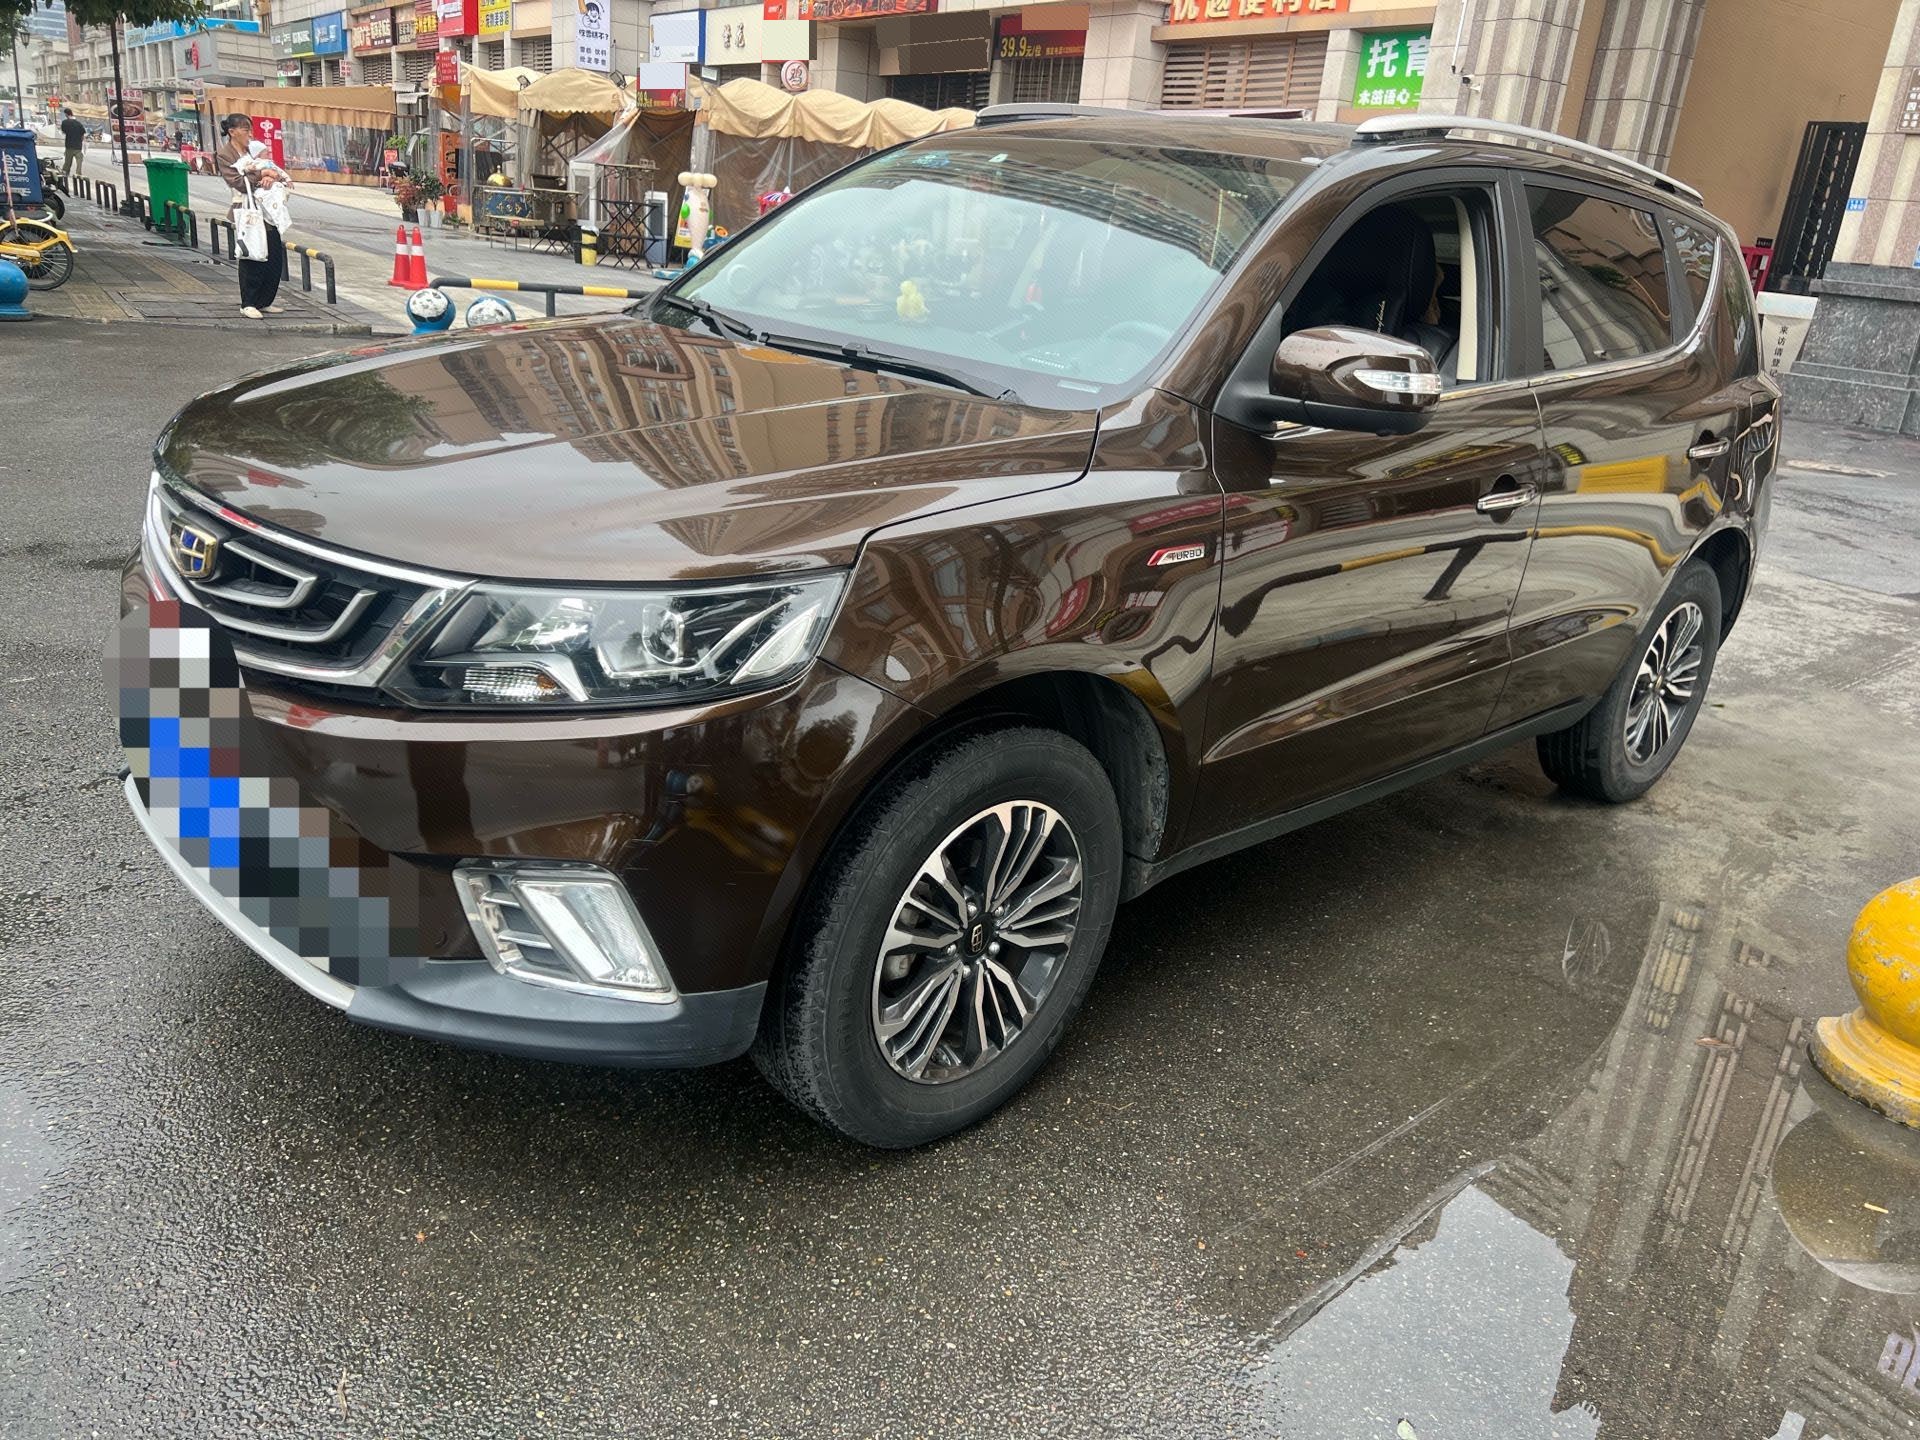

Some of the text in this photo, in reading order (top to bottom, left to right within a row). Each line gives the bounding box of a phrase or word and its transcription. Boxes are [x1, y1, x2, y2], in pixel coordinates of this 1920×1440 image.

[1366, 36, 1430, 78] 托育
[1770, 325, 1789, 378] 来访请登记
